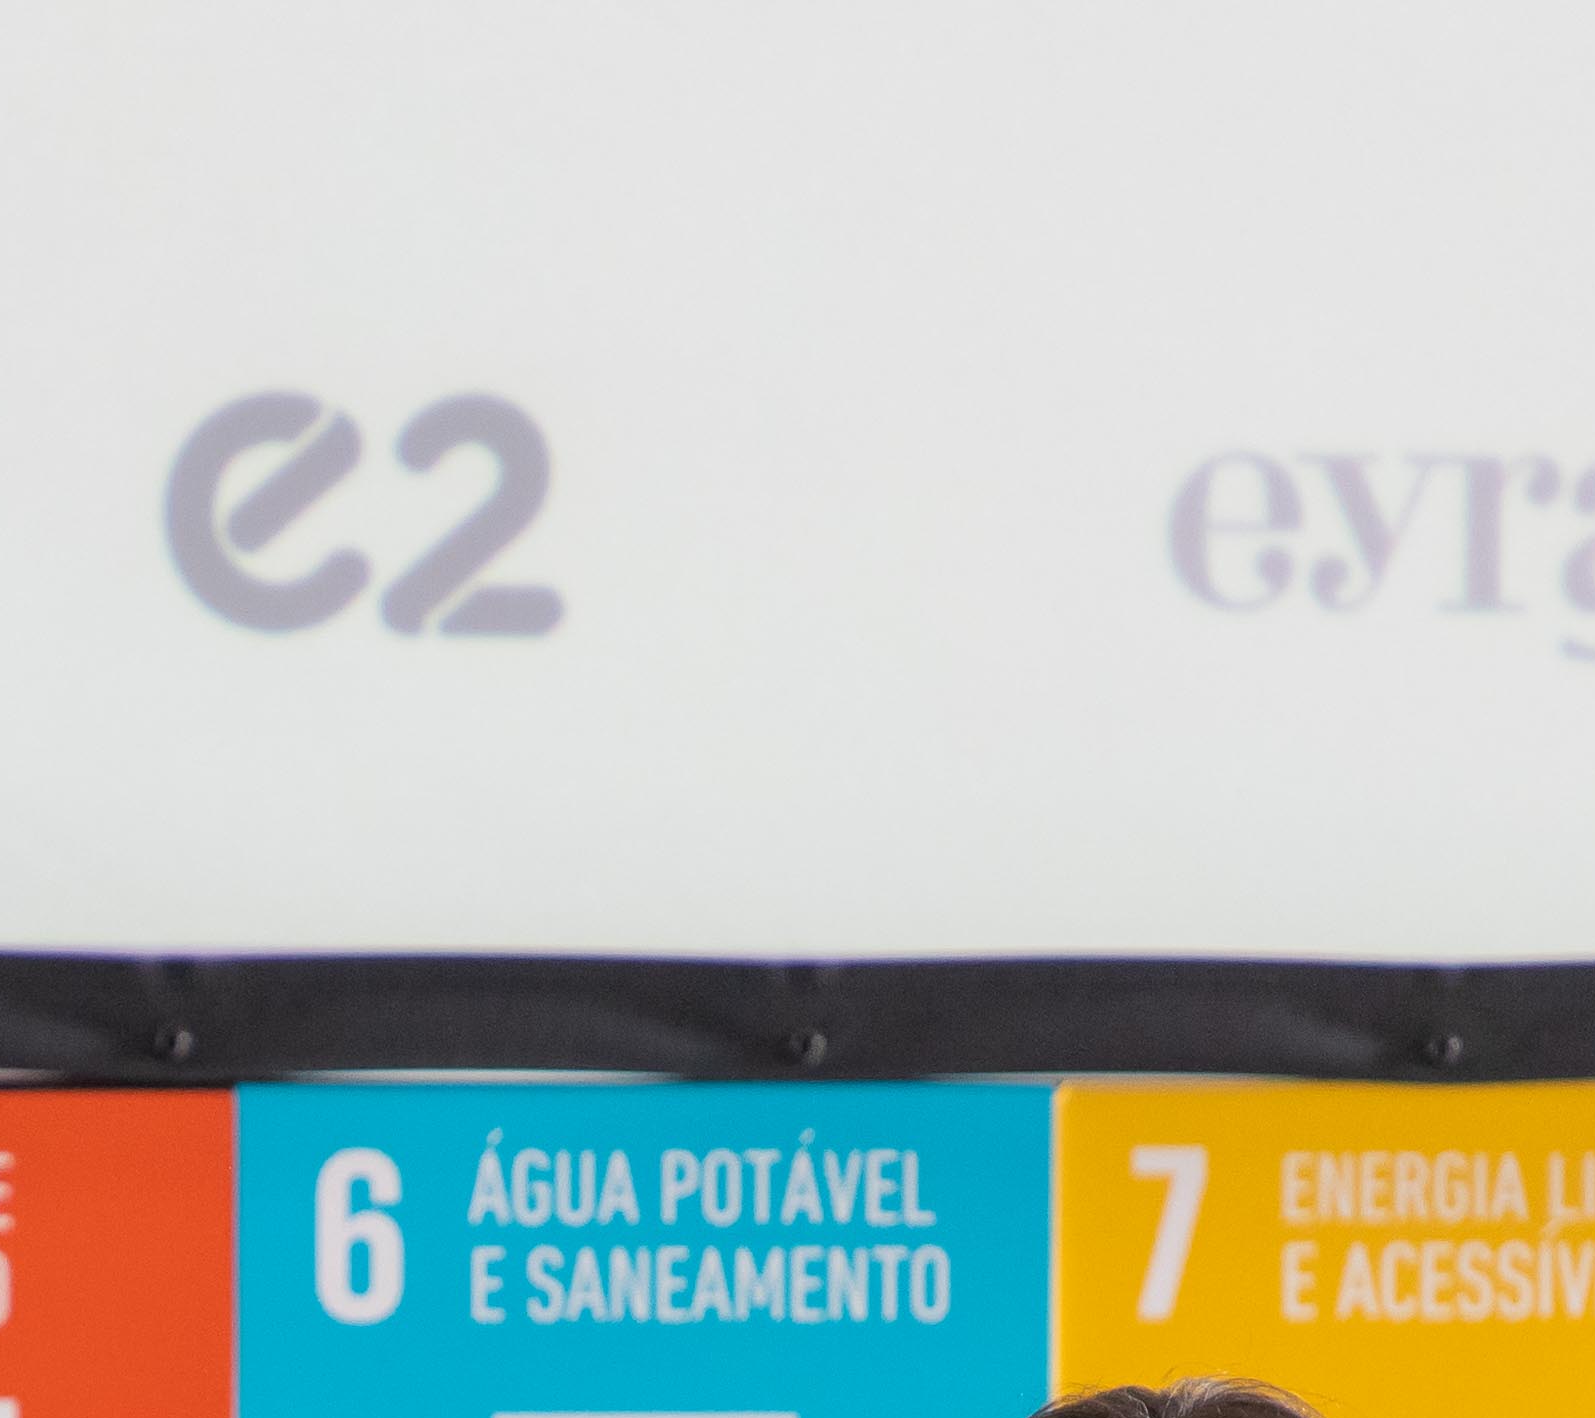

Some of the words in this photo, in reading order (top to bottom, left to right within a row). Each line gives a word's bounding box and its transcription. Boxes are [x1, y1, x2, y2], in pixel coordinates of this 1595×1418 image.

[468, 1129, 639, 1227] ÁGUA
[661, 1129, 936, 1227] POTÁVEL
[1281, 1151, 1528, 1224] ENERGIA
[315, 1148, 404, 1325] 6
[1130, 1145, 1208, 1322] 7
[471, 1246, 505, 1323] E
[526, 1245, 950, 1324] SANEAMENTO
[1281, 1241, 1317, 1322] E
